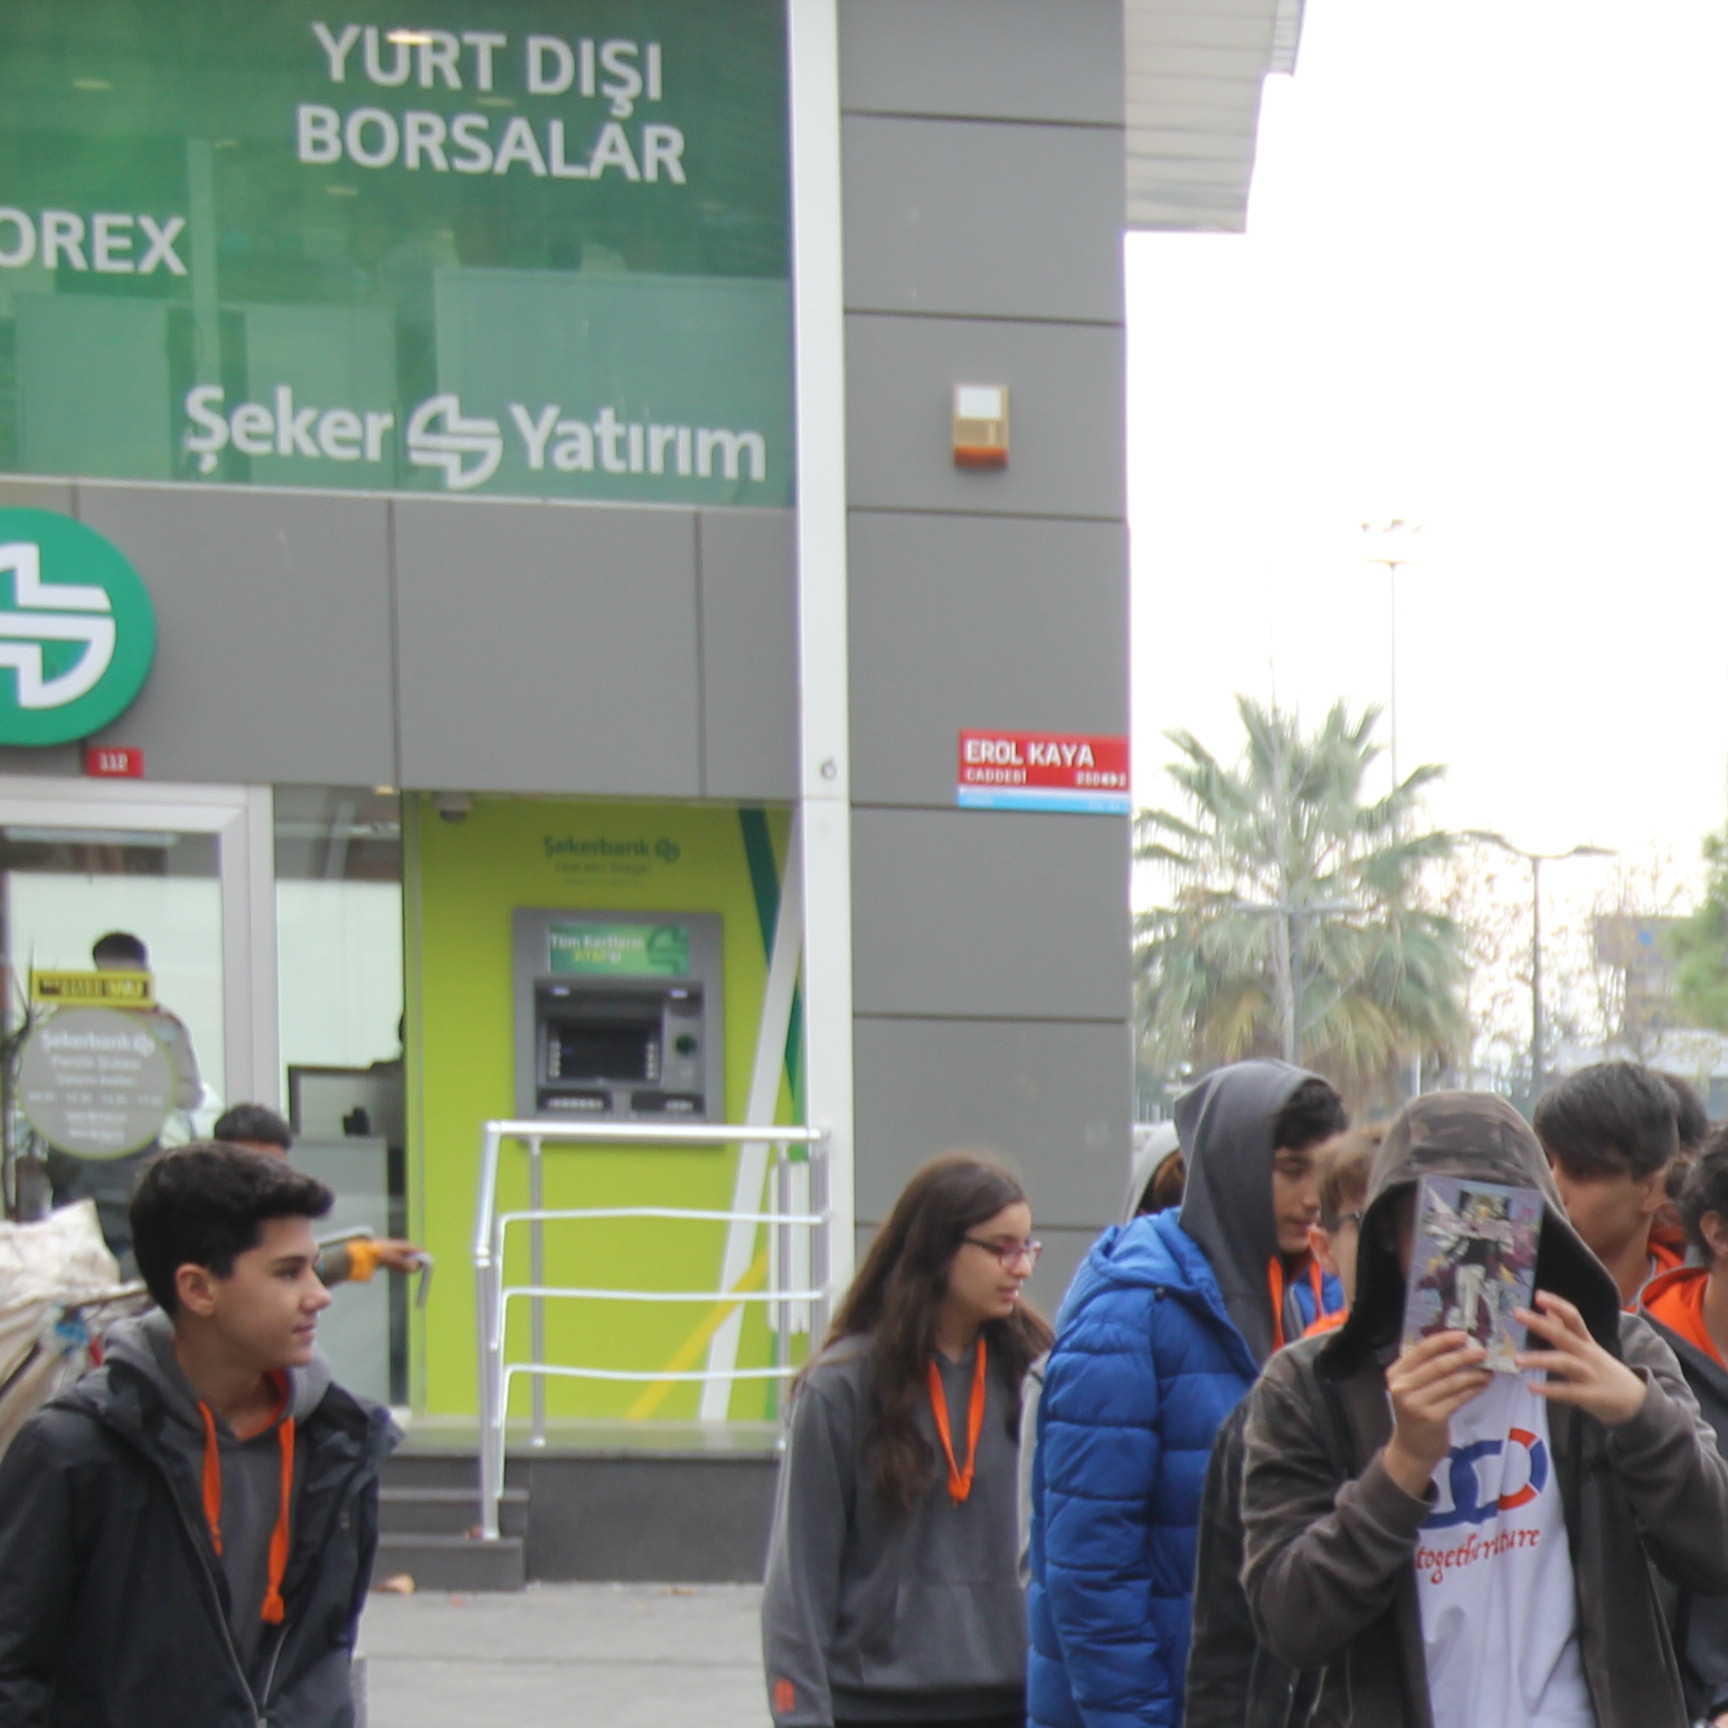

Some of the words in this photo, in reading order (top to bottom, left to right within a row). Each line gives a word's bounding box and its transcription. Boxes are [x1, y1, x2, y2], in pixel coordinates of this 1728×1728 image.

[312, 22, 507, 94] YURT
[524, 36, 664, 118] DIŞI
[297, 104, 686, 184] BORSALAR
[185, 385, 393, 474] Şeker
[508, 403, 766, 482] Yatırım
[965, 738, 1024, 766] EROL
[1028, 742, 1095, 768] KAYA
